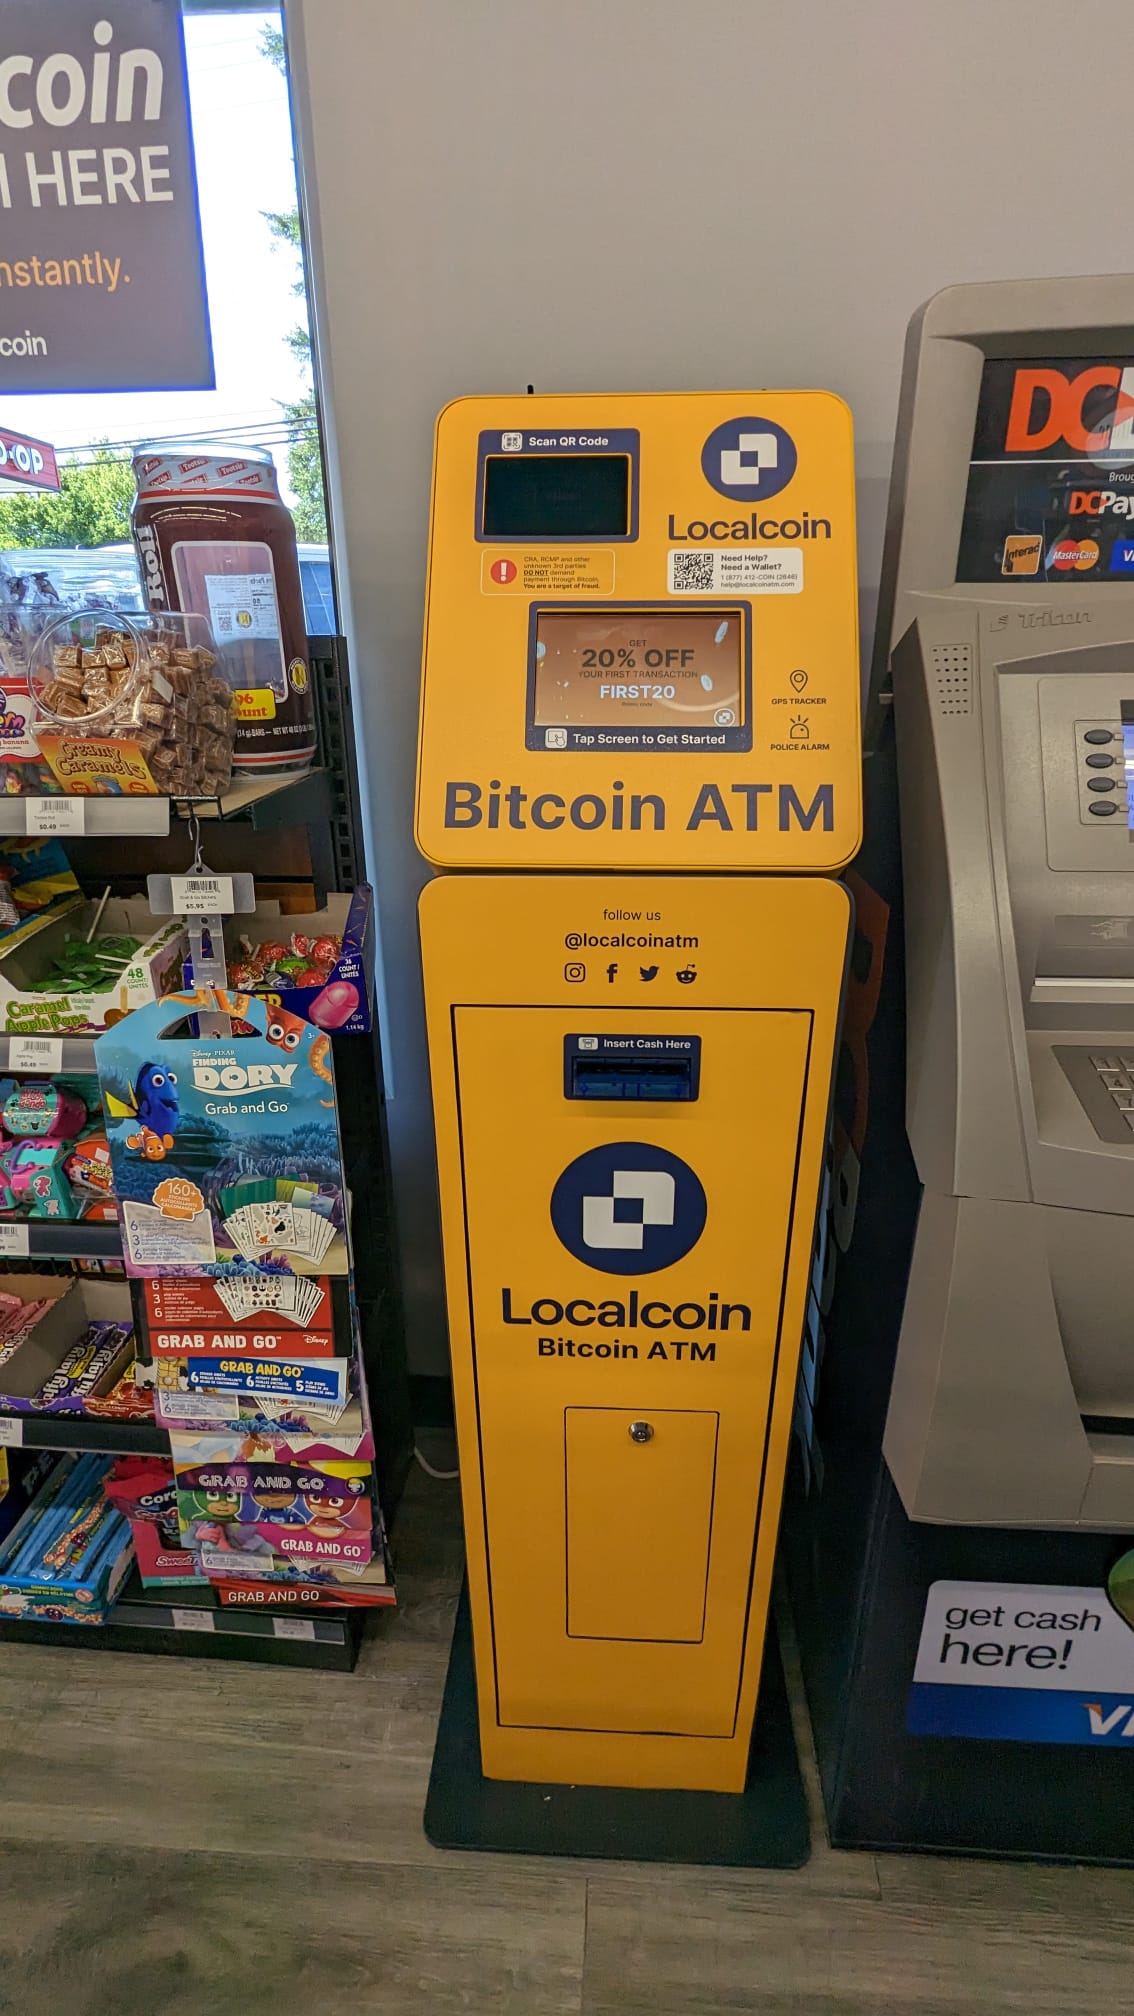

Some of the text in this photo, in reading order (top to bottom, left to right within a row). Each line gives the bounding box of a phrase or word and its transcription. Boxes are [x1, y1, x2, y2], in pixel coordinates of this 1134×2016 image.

[26, 145, 173, 208] HERE
[529, 436, 608, 446] Scan QR Code
[668, 512, 832, 540] Localcoin
[744, 554, 768, 562] Help?
[1053, 551, 1097, 560] MasterCard
[582, 648, 694, 668] 20% OFF
[634, 670, 698, 678] TRANSACTION
[600, 685, 676, 698] FIRST20
[573, 734, 726, 745] Tap Screen to Get Started
[58, 740, 121, 763] Creamy
[56, 756, 146, 780] Caramels
[444, 780, 834, 832] Bitcoin ATM
[603, 908, 661, 921] follow us
[564, 933, 699, 950] @localcoinatm
[128, 968, 144, 978] 48
[6, 995, 72, 1019] Caramel
[603, 1039, 691, 1049] Insert Cash Here
[193, 1058, 236, 1066] FINDING
[194, 1064, 298, 1090] DORY
[206, 1101, 288, 1115] Grab and Go
[168, 1183, 197, 1196] 160+
[131, 1220, 138, 1231] 6
[132, 1234, 140, 1246] 3
[135, 1248, 142, 1260] 6
[152, 1280, 159, 1290] 6
[154, 1294, 160, 1304] 3
[154, 1308, 162, 1318] 6
[502, 1288, 752, 1331] Localcoin
[158, 1334, 204, 1348] GRAB
[212, 1335, 246, 1348] AND
[302, 1334, 328, 1346] Disney
[538, 1338, 716, 1361] Bitcoin ATM
[220, 1360, 254, 1374] GRAB
[256, 1362, 281, 1376] AND
[190, 1372, 199, 1383] 6
[246, 1376, 254, 1388] 6
[296, 1380, 304, 1392] 5
[164, 1403, 172, 1413] 6
[198, 1475, 325, 1491] GRAB AND GO
[281, 1538, 313, 1552] GRAB
[316, 1540, 341, 1555] AND
[228, 1591, 319, 1602] GRAB AND GO
[946, 1606, 1102, 1632] get cash
[940, 1634, 1072, 1670] here!
